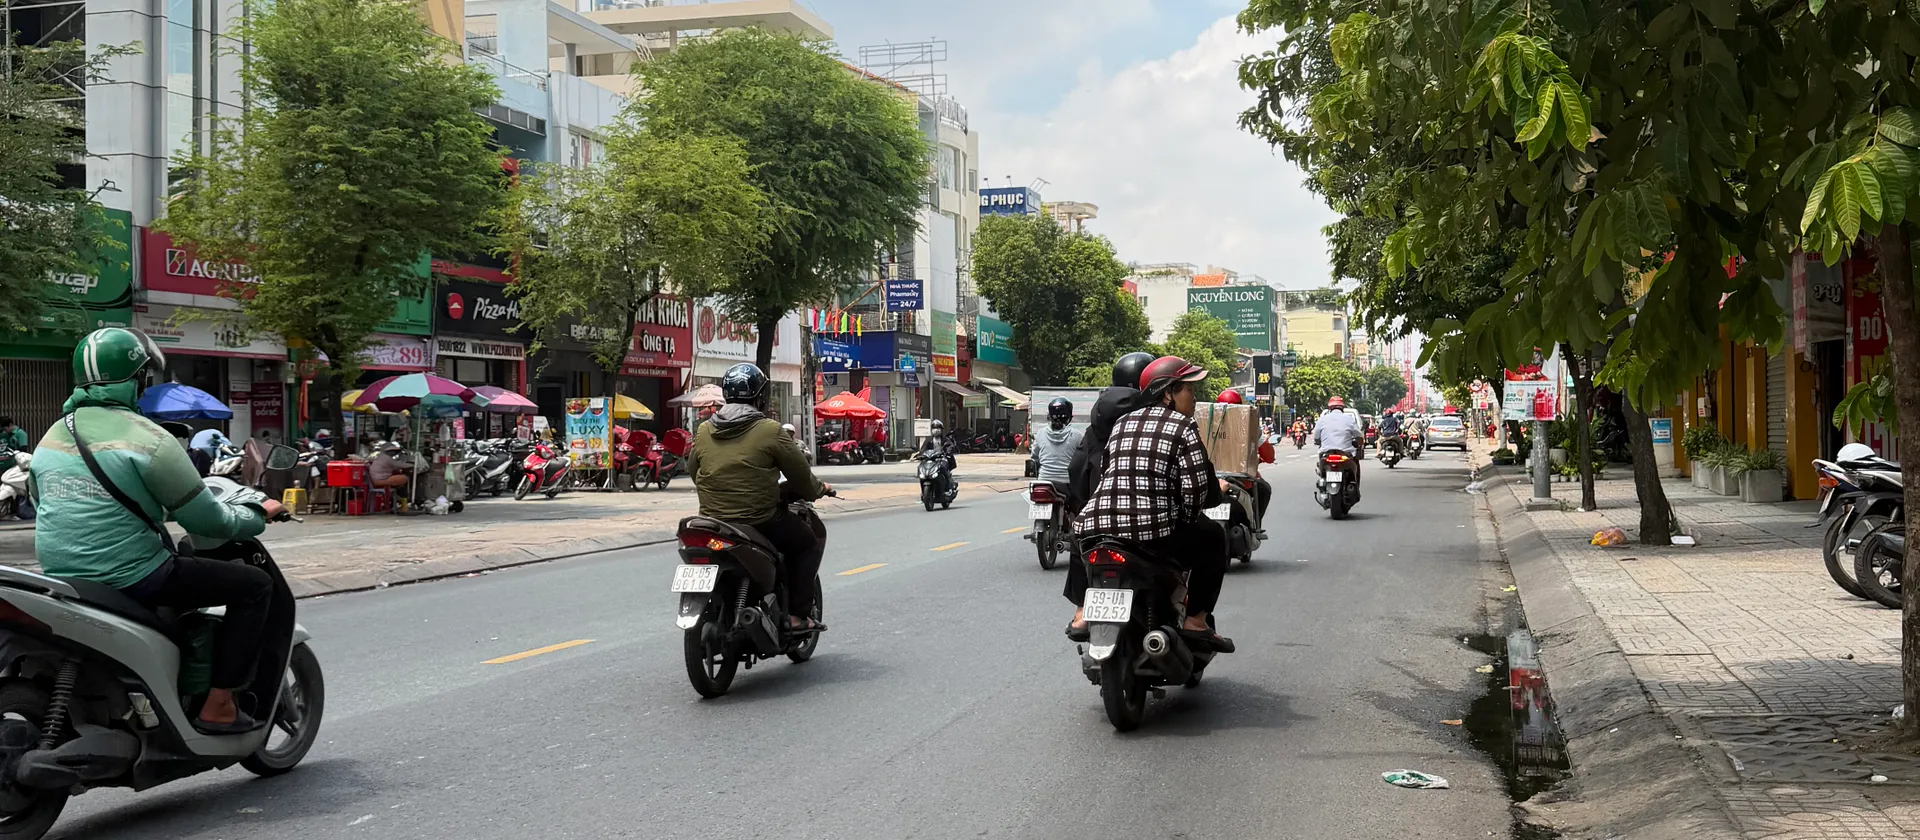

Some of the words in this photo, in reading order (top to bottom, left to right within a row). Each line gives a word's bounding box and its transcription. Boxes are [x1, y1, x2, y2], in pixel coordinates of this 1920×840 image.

[990, 192, 1024, 208] PHỤC
[900, 300, 917, 308] 24/7
[1190, 288, 1234, 304] NGUYỄN
[1235, 290, 1265, 302] LONG
[473, 297, 506, 321] Pizza
[657, 297, 690, 329] KHOA
[642, 330, 662, 353] ÔNG
[663, 336, 676, 358] TẠ
[400, 346, 423, 365] 89
[570, 424, 605, 436] LUXY
[1092, 591, 1125, 606] 59-UA
[1086, 605, 1127, 620] 052.52
